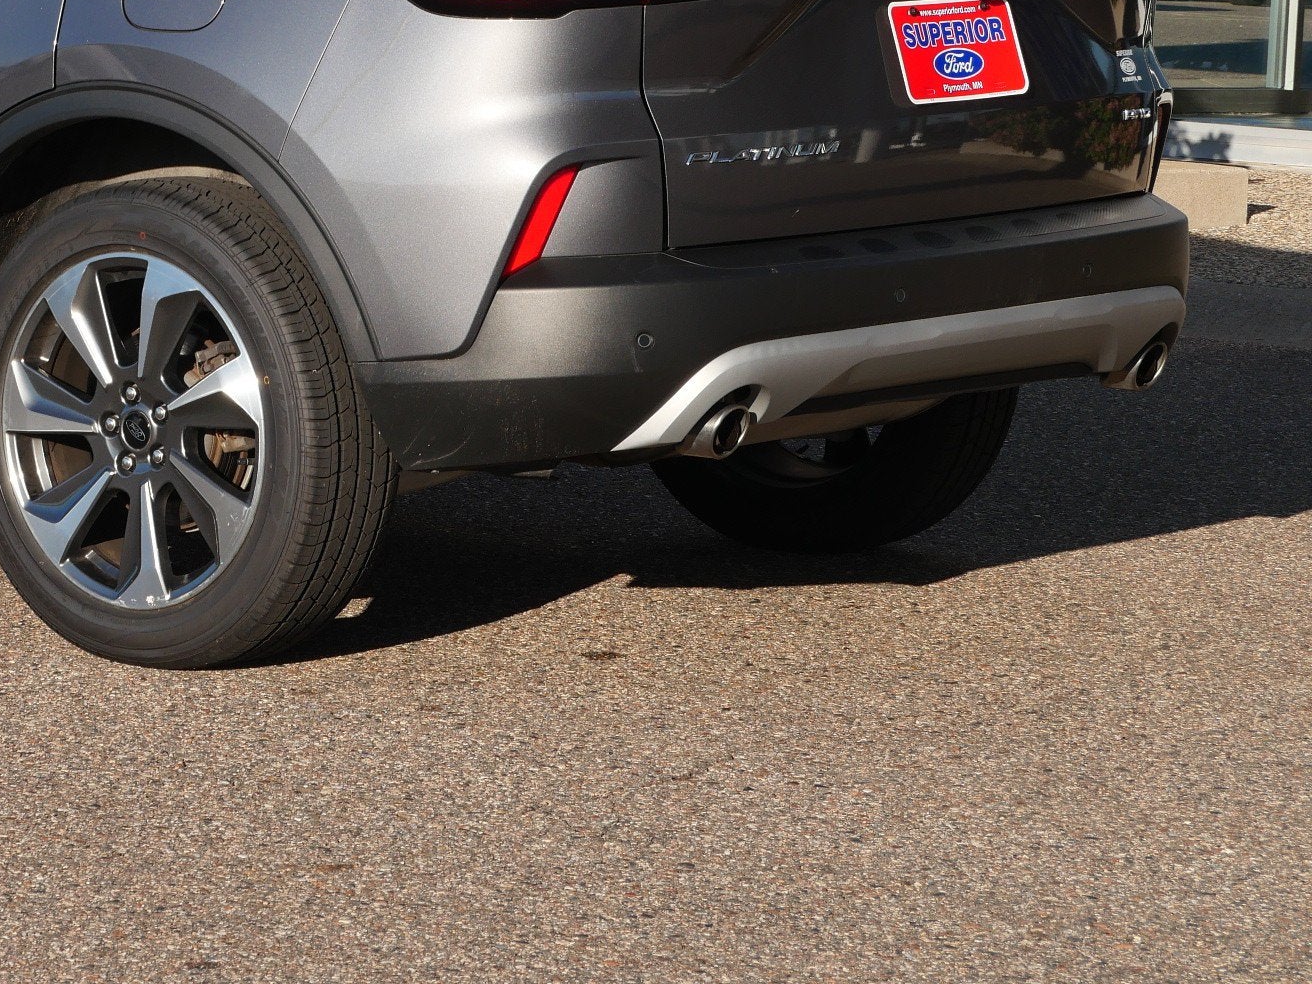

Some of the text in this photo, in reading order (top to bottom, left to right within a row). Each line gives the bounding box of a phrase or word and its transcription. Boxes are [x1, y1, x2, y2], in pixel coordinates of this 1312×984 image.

[919, 5, 976, 17] www.superiorford.com
[901, 17, 1006, 49] SUPERIOR
[943, 52, 975, 74] Ford
[943, 80, 983, 94] Plymouth, MN
[685, 140, 840, 166] PLATINUM
